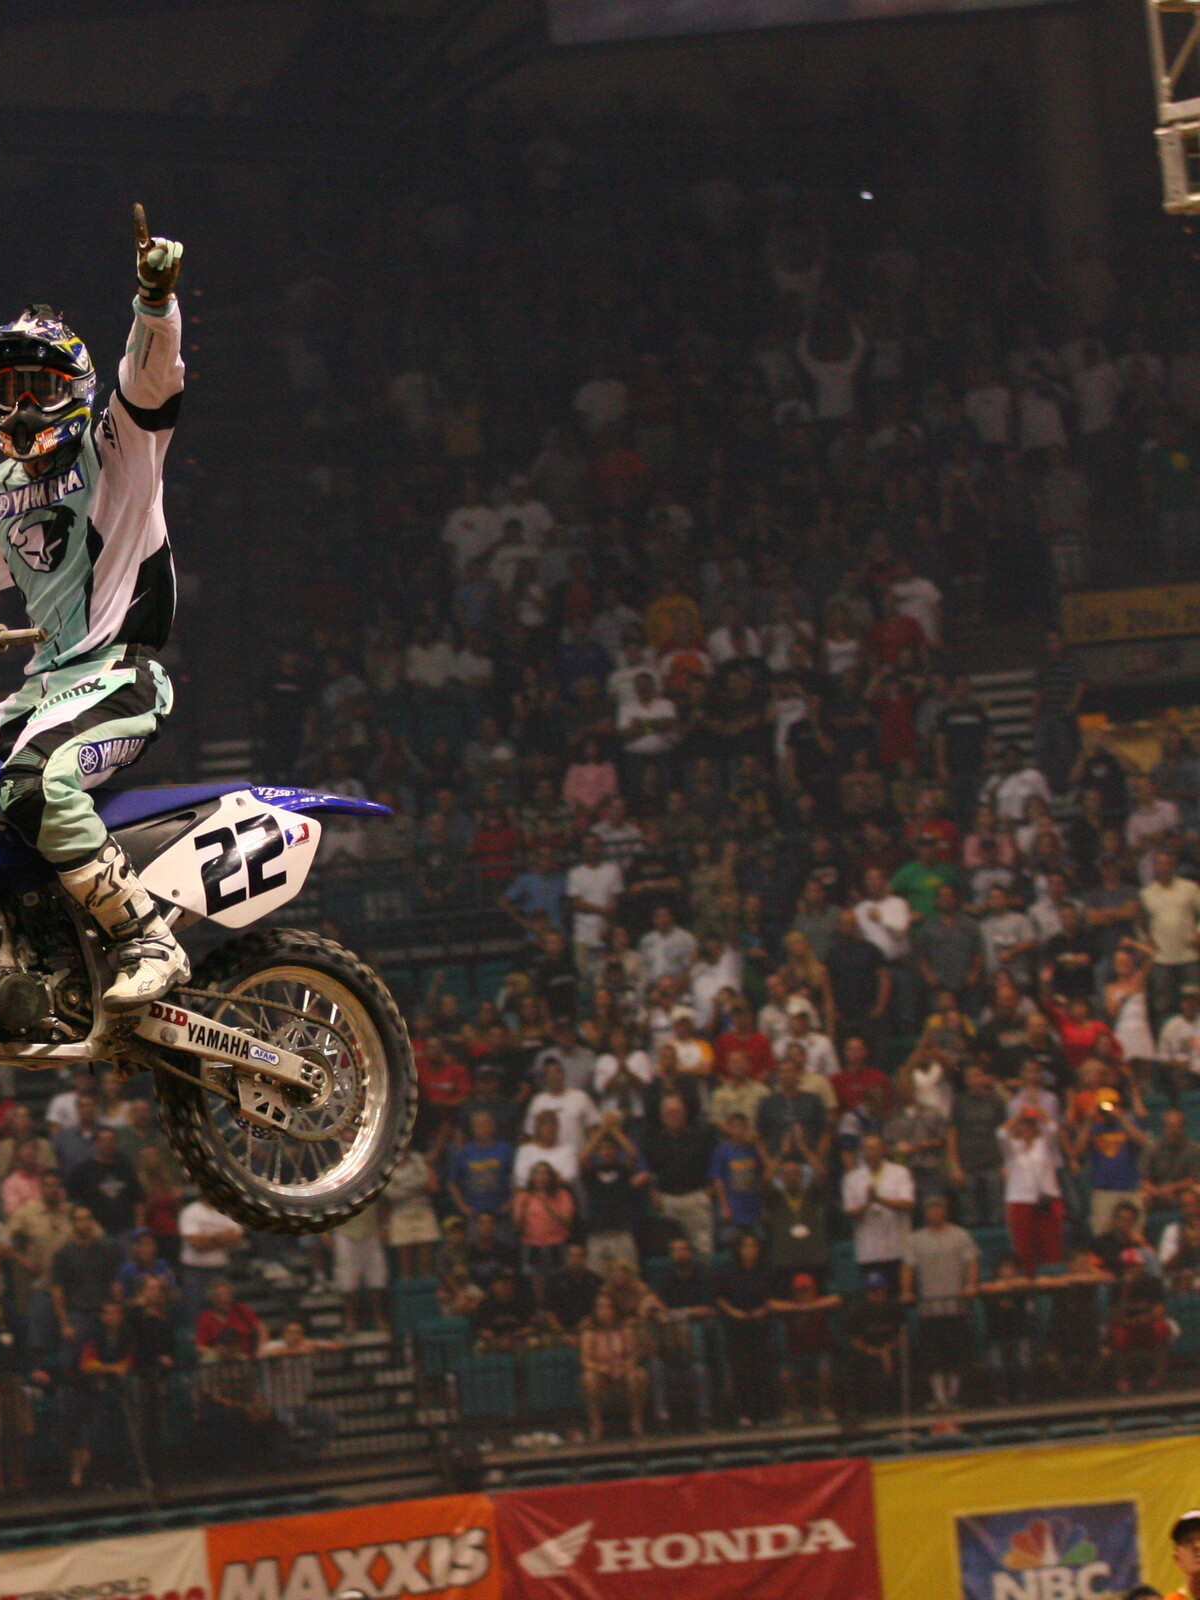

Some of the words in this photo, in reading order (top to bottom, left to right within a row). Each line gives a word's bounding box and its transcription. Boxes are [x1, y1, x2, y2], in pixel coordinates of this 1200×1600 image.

[194, 813, 287, 917] 22
[149, 1003, 188, 1026] DID
[187, 1022, 251, 1060] YAMAHA
[254, 1049, 277, 1063] AFAM
[219, 1528, 490, 1600] MAXXIS
[596, 1519, 855, 1574] HONDA
[991, 1561, 1112, 1600] NBC
